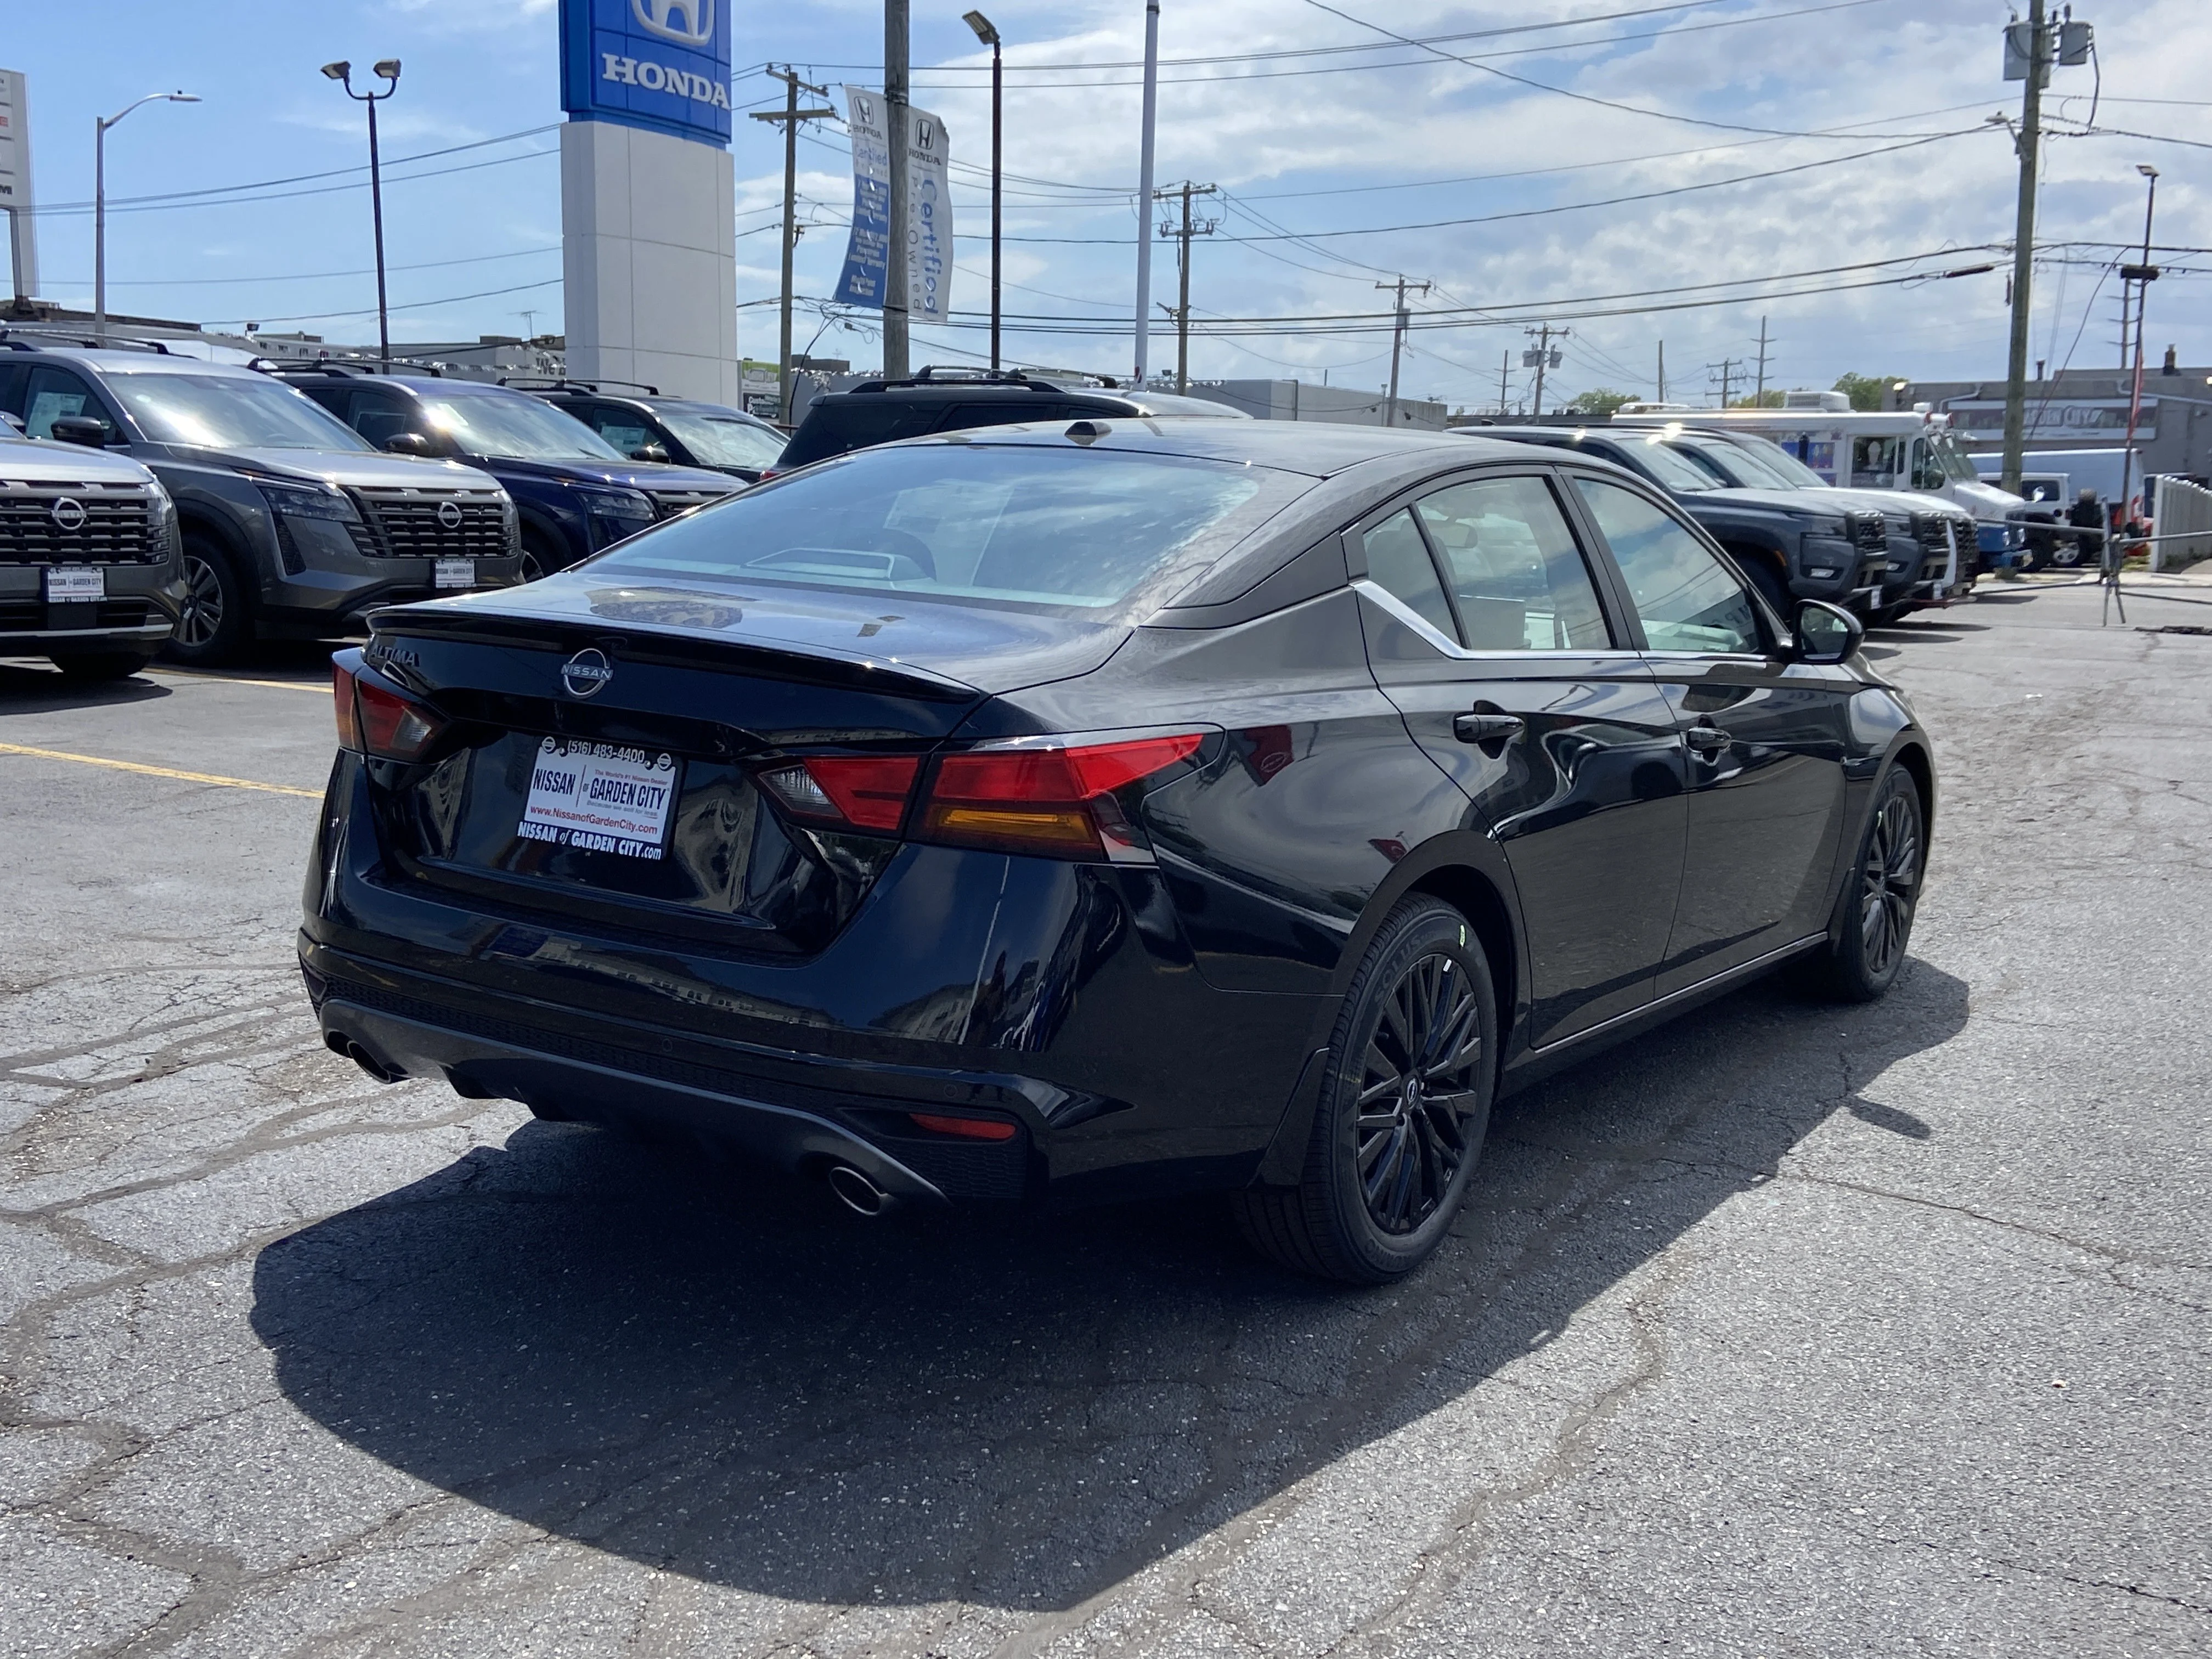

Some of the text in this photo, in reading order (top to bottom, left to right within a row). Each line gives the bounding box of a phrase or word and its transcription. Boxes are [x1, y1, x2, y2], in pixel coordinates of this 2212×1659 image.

[601, 53, 731, 110] HONDA
[909, 148, 941, 166] HONDA
[921, 178, 943, 314] Certified
[370, 645, 415, 666] ALTIMA
[562, 664, 613, 679] NISSAN
[568, 740, 645, 764] (516) 483-4400
[533, 768, 576, 795] NISSAN
[589, 777, 637, 805] GARDEN
[637, 785, 666, 810] CITY
[531, 806, 658, 834] www.NissanofGardenCity.com
[517, 821, 662, 861] NISSAN of GARDEN CITY.com
